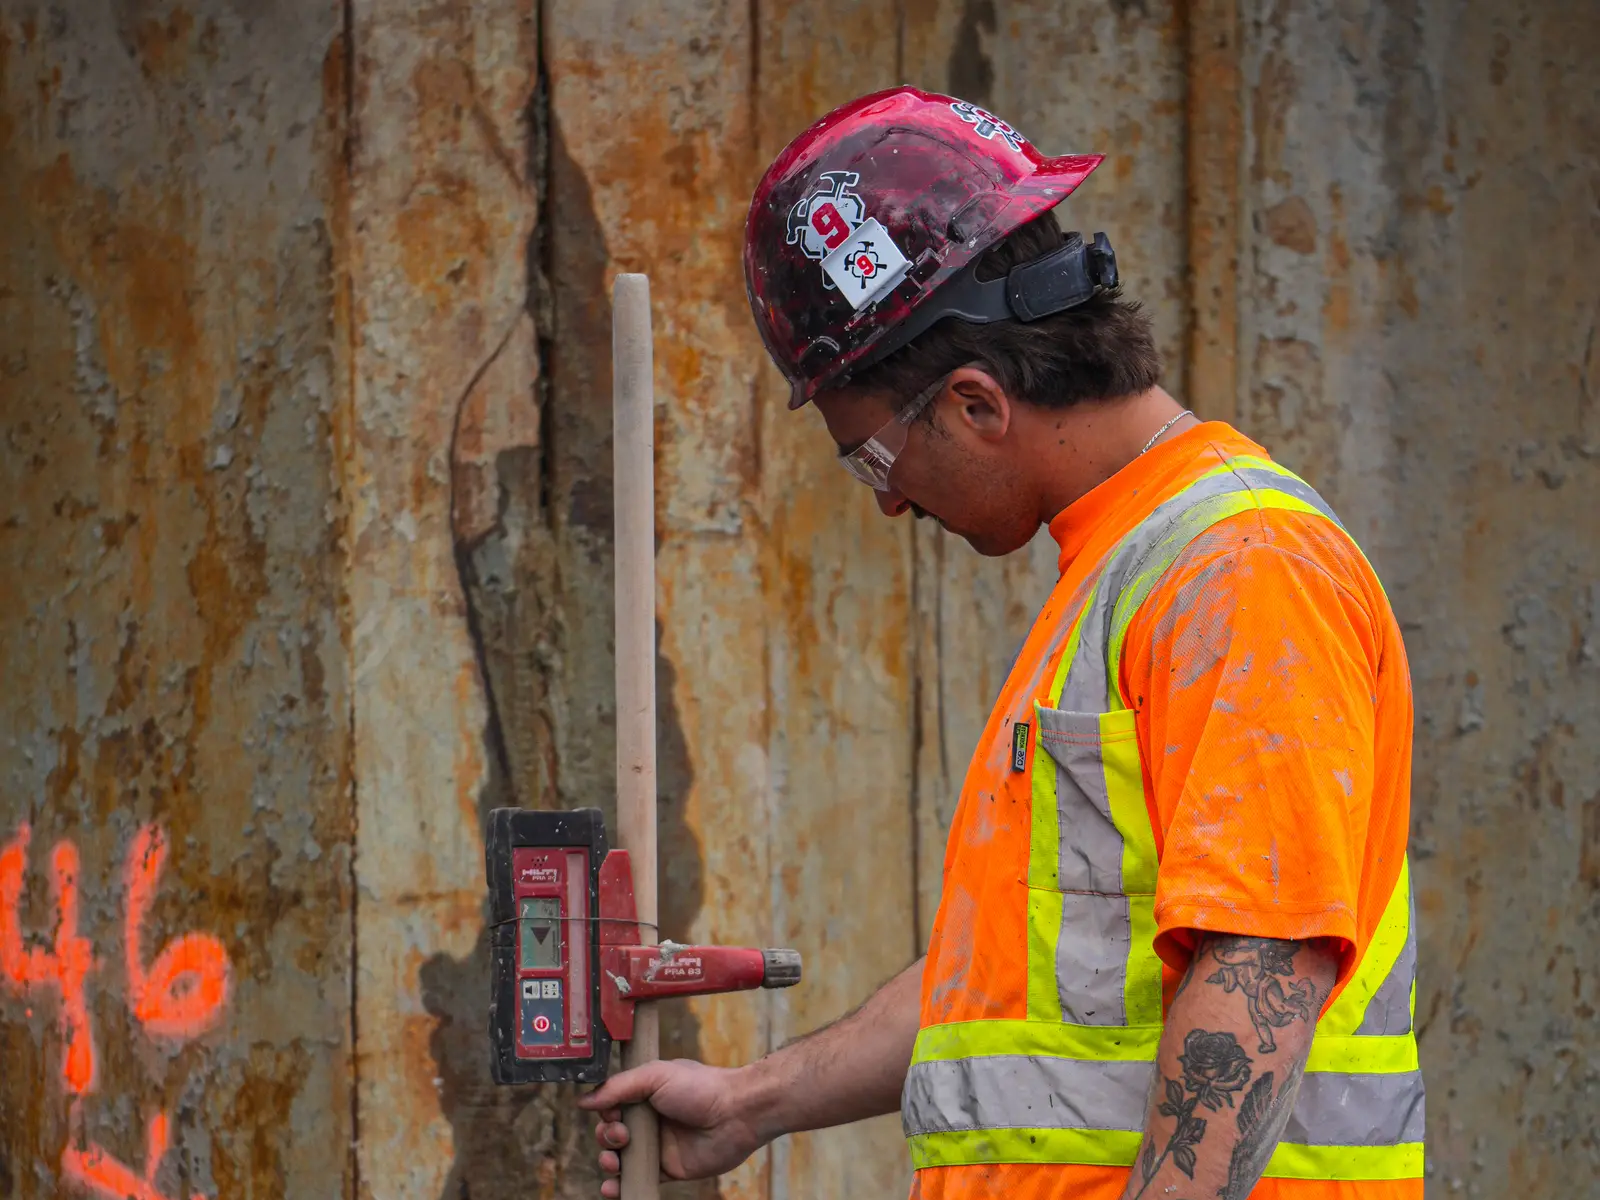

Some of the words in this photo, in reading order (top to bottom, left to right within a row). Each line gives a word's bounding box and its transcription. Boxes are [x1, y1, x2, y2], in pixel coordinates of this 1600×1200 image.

[811, 202, 850, 249] 9
[856, 255, 874, 276] 9
[0, 820, 229, 1093] 46
[664, 967, 686, 975] PRA
